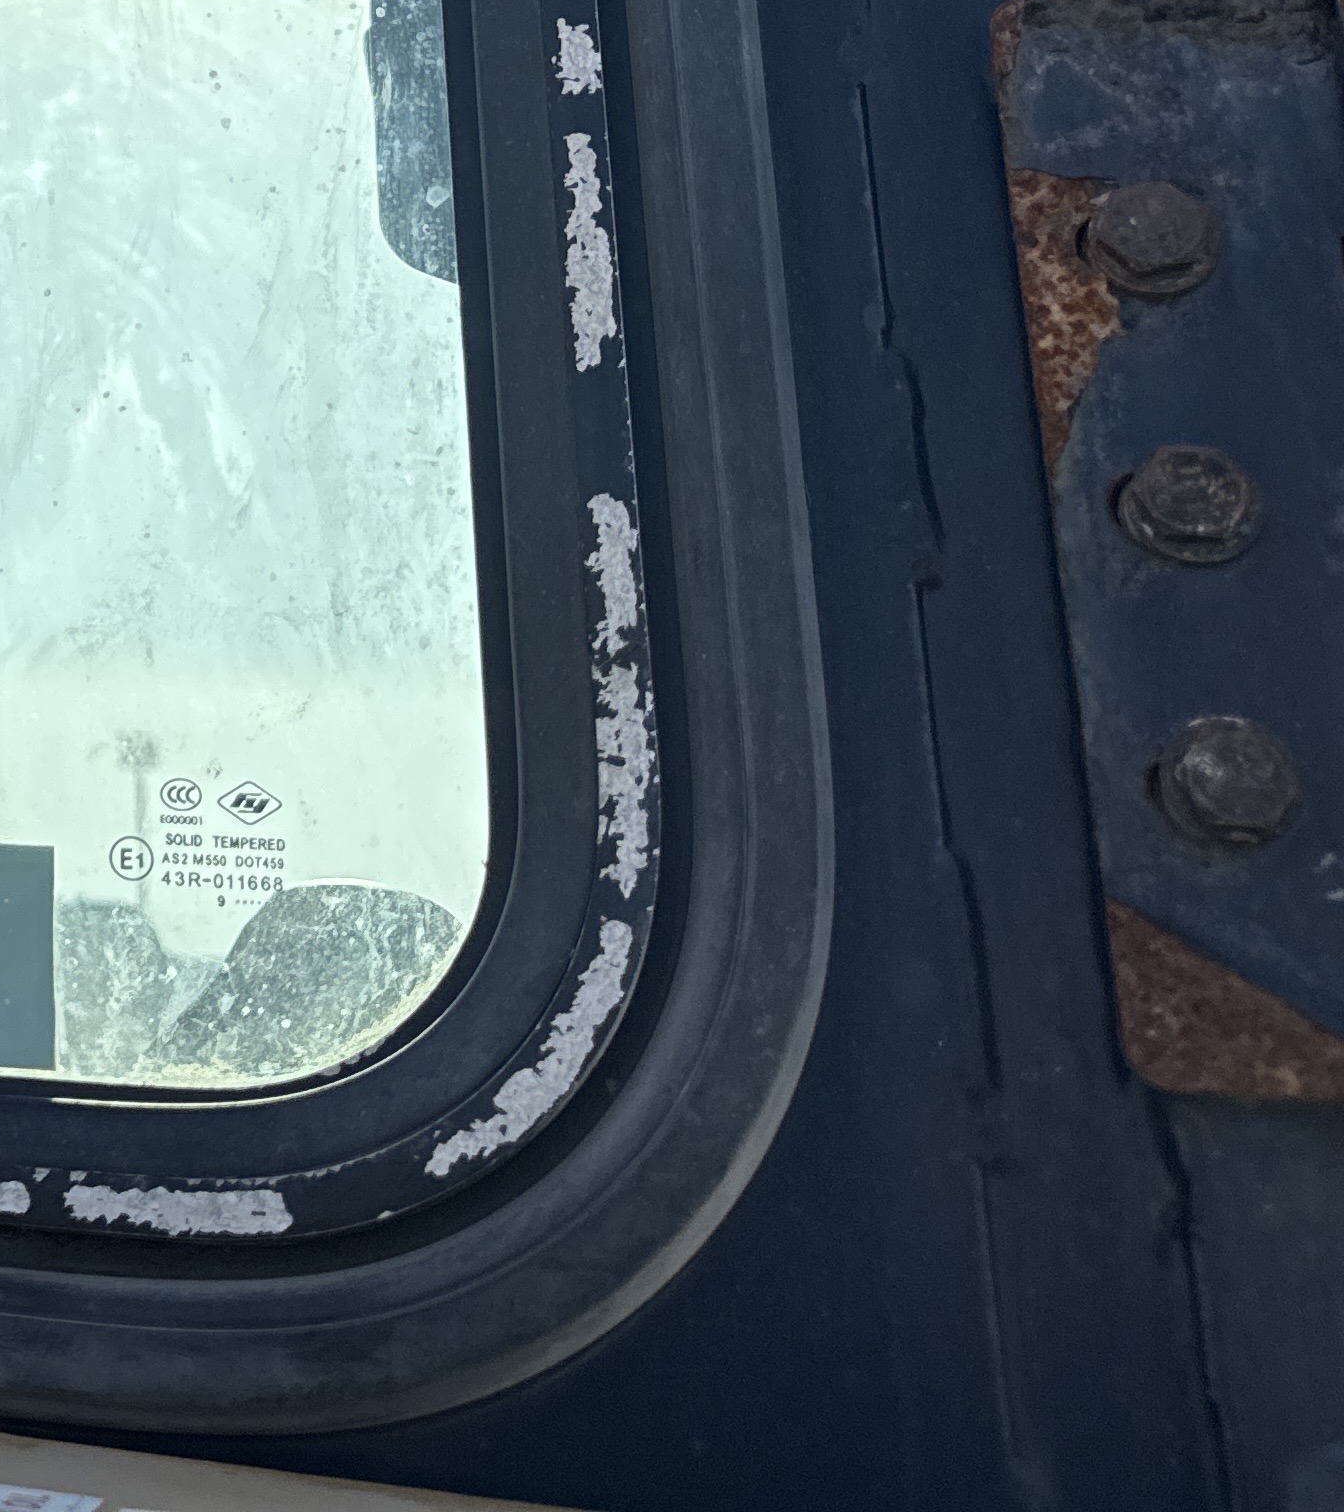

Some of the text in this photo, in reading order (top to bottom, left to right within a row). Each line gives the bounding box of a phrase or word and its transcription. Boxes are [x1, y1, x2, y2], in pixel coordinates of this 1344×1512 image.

[160, 814, 203, 826] E000001
[165, 833, 286, 852] SOLID TEMPERED
[161, 852, 285, 870] AS2 M550 DOT459
[161, 870, 284, 892] 43R-011668
